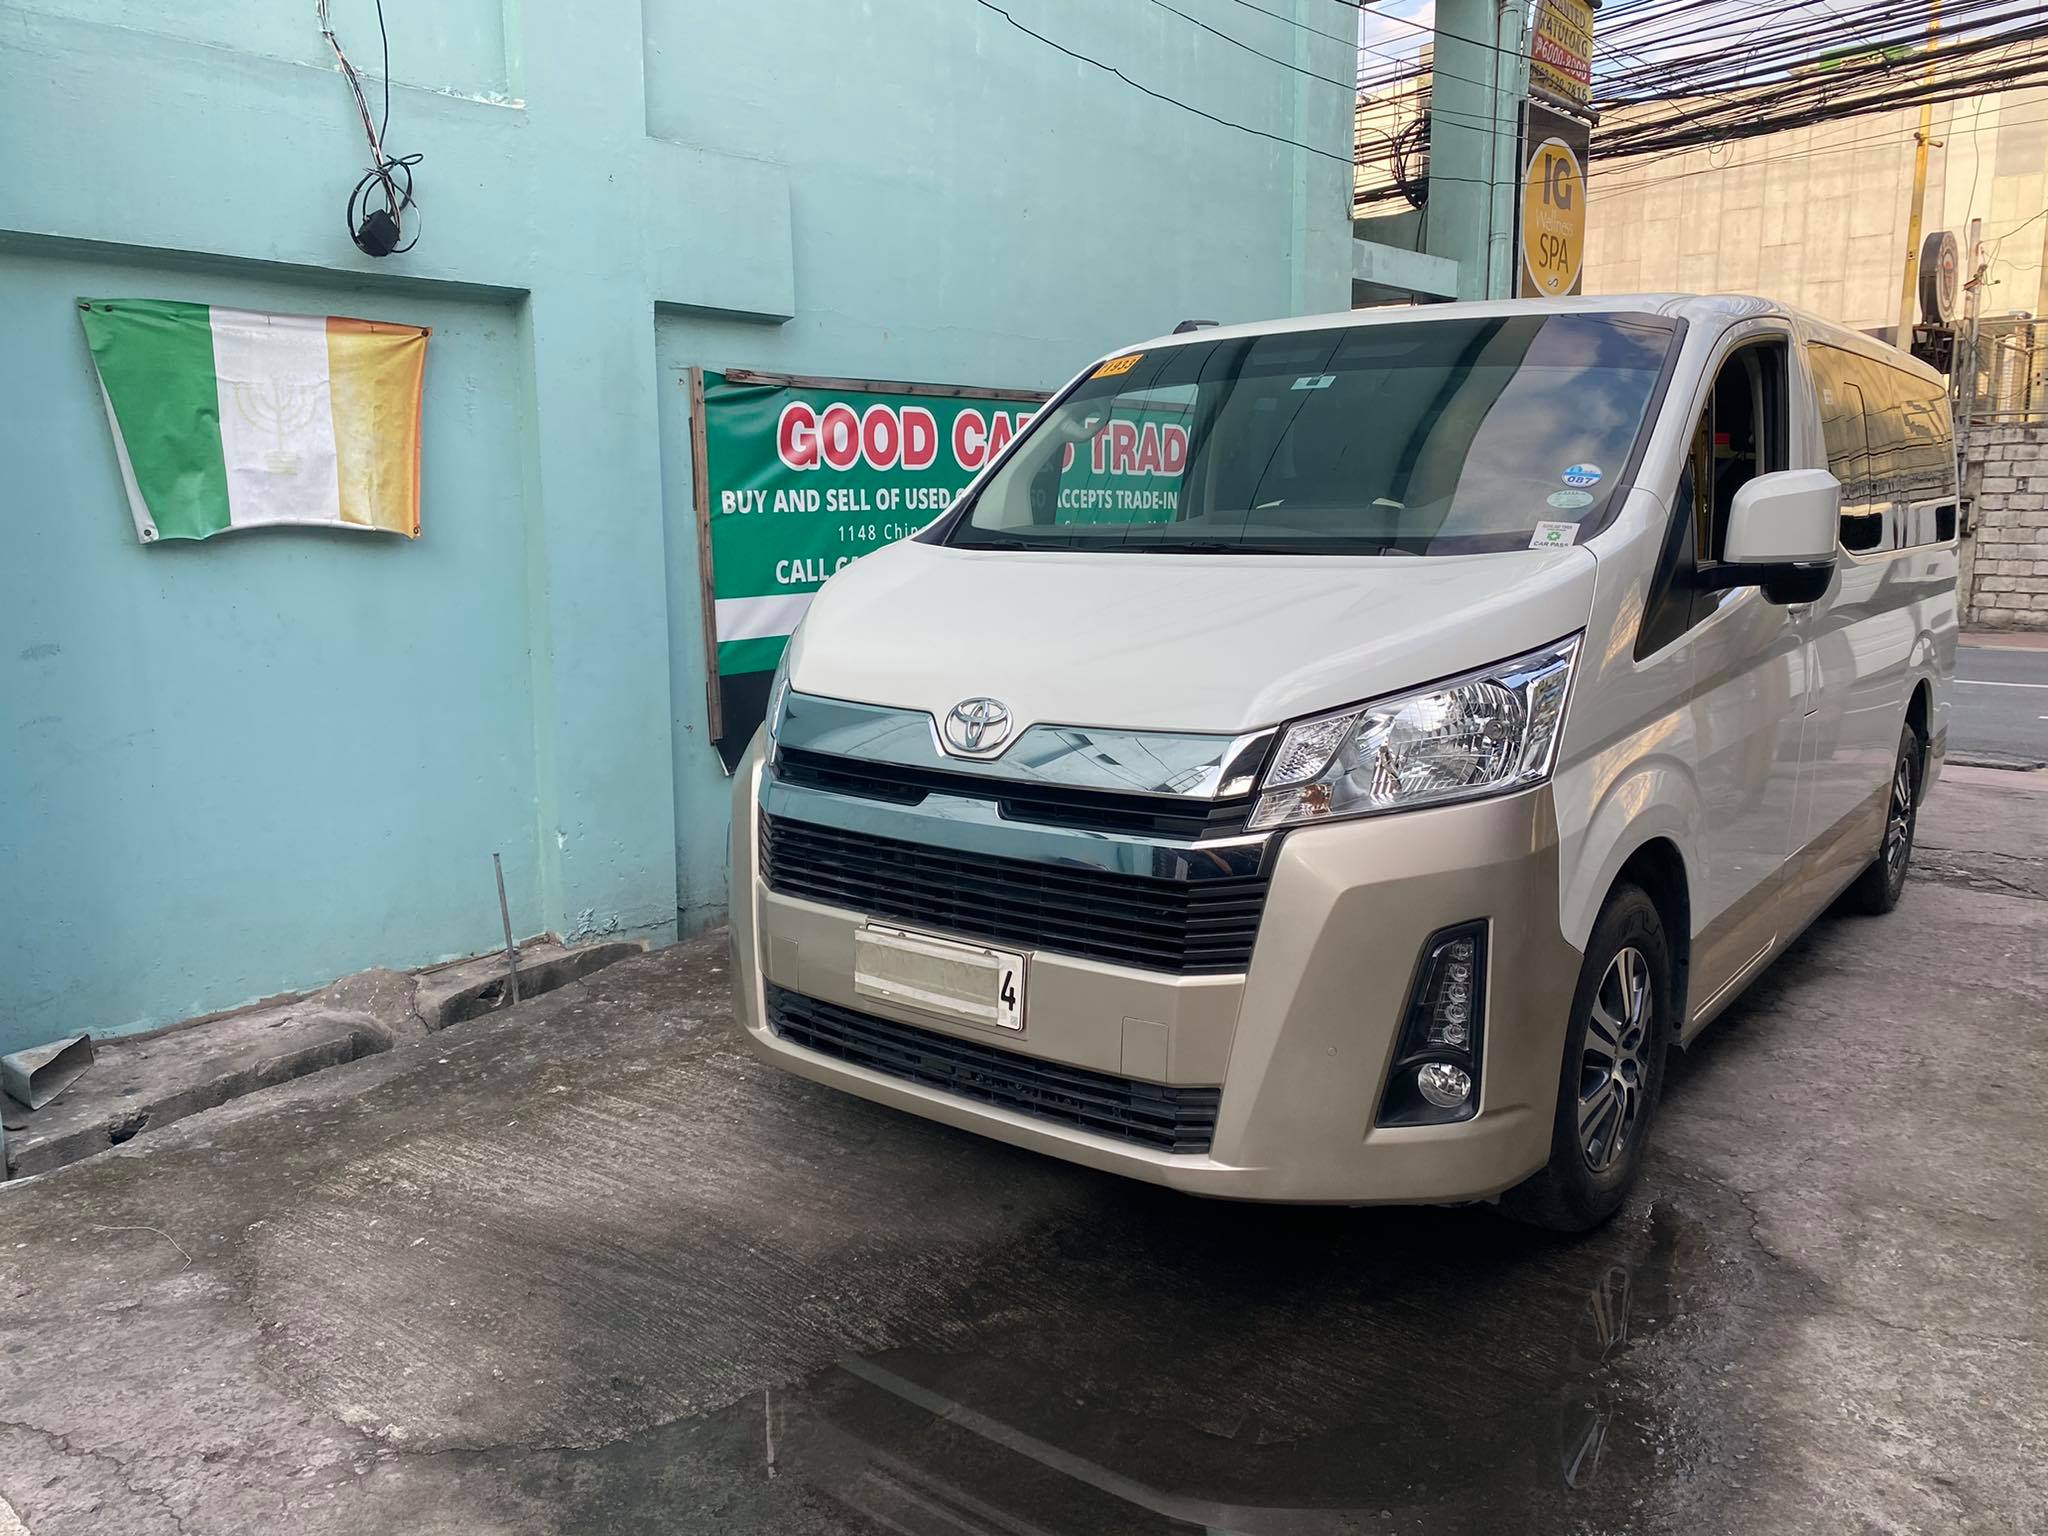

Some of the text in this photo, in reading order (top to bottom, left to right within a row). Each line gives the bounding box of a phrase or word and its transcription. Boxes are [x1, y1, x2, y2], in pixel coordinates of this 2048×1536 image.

[1543, 153, 1572, 210] IG
[1536, 207, 1574, 237] Wellness
[1539, 233, 1569, 274] SPA
[777, 401, 1190, 477] GOOD CA TRAD
[1567, 475, 1593, 485] 087
[721, 489, 767, 514] BUY
[773, 489, 820, 513] AND
[826, 488, 871, 512] SELL
[876, 488, 899, 510] OF
[905, 487, 950, 510] USED
[1116, 490, 1177, 509] TRADE-IN
[838, 524, 876, 541] 1148
[775, 558, 829, 584] CALL
[1000, 970, 1016, 1011] 4
